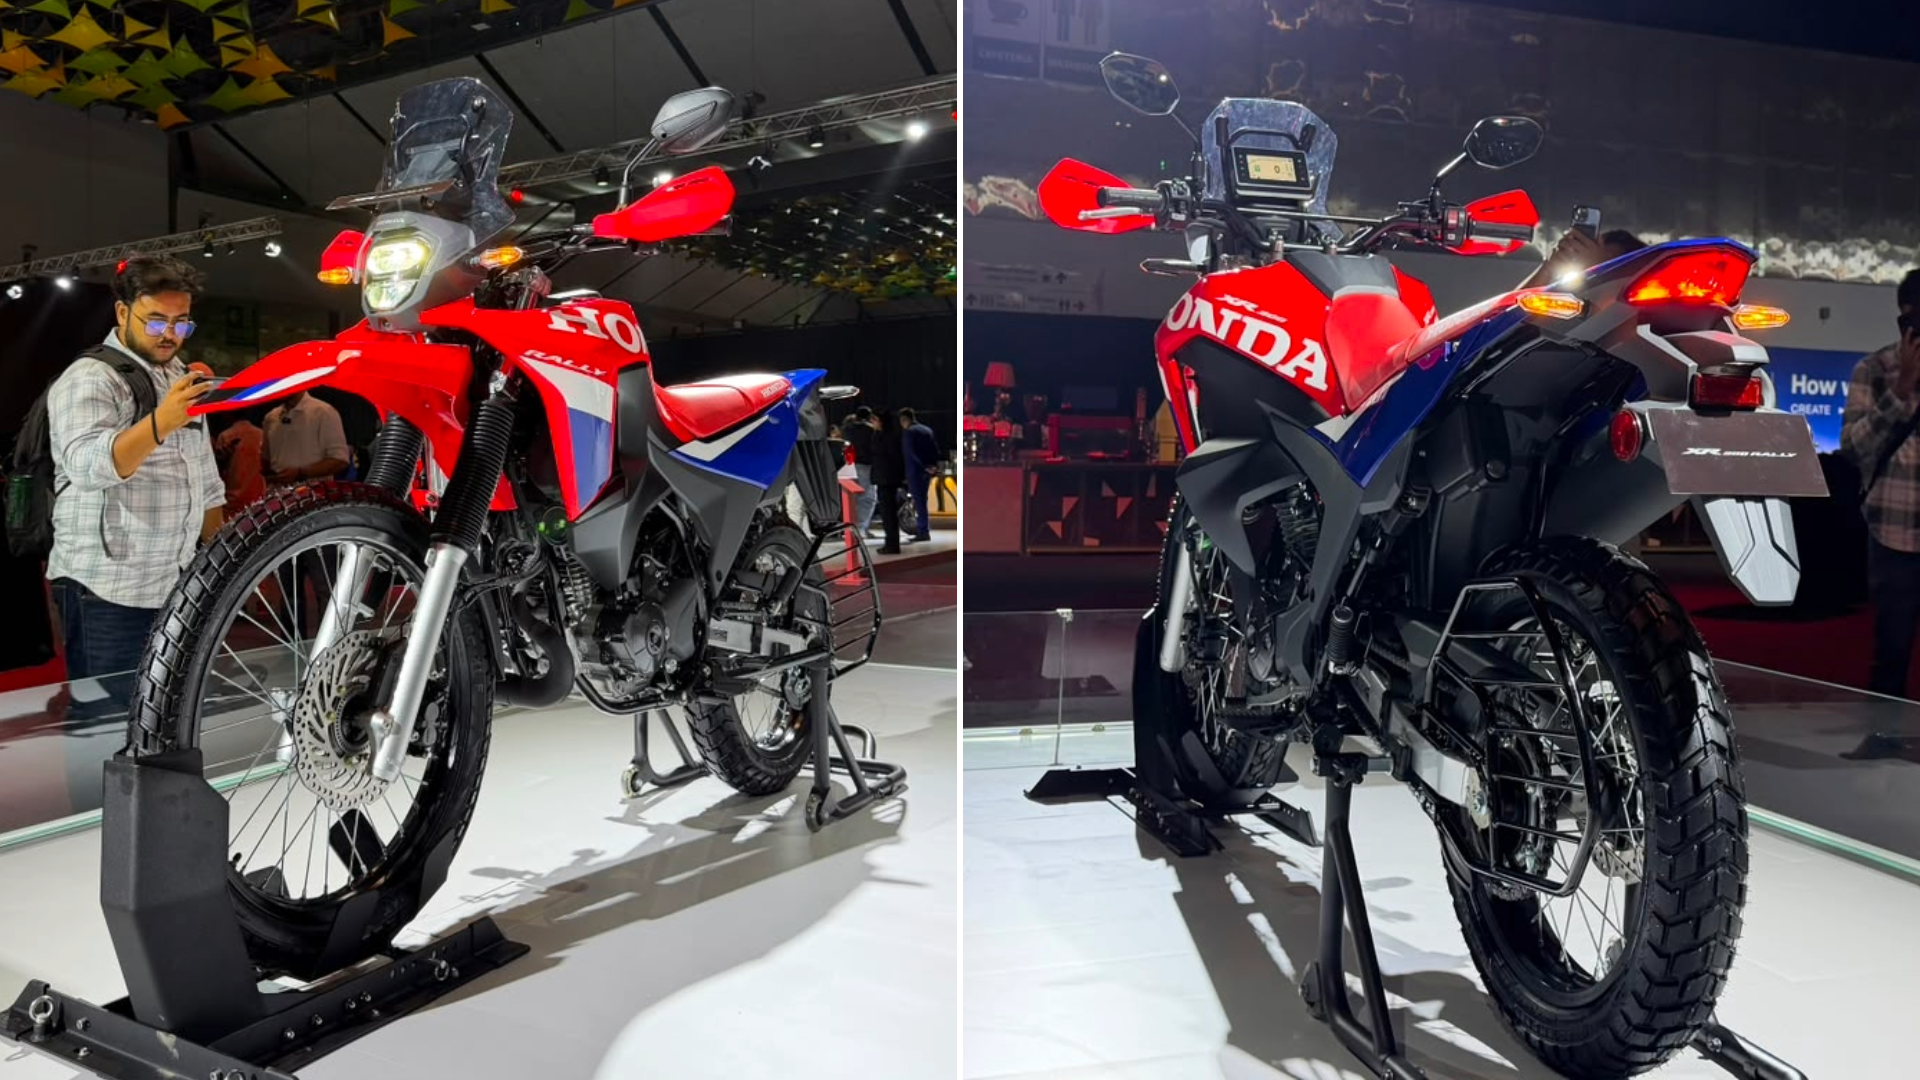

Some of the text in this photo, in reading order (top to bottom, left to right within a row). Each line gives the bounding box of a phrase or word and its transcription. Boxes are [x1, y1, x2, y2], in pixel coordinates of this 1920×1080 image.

[1214, 294, 1259, 312] XR
[547, 306, 648, 355] HO
[523, 349, 607, 376] RALLY
[1791, 373, 1838, 396] How
[1790, 403, 1832, 416] CREATE
[1682, 447, 1722, 456] XR
